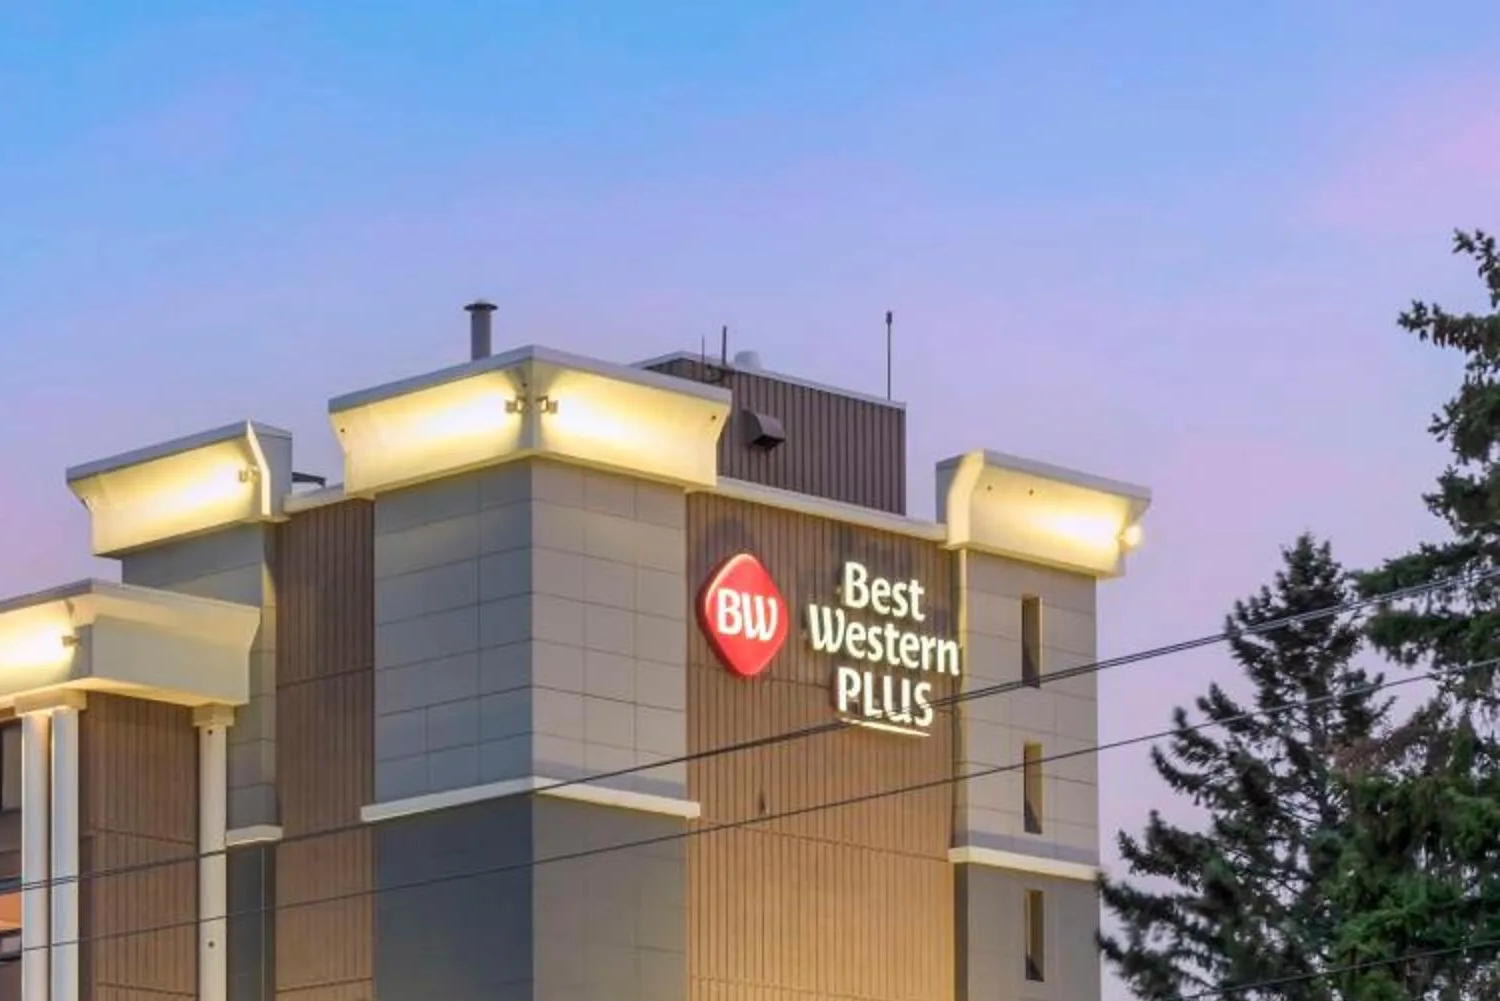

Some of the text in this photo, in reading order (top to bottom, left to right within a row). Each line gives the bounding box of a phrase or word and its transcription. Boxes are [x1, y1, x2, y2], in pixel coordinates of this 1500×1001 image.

[717, 588, 778, 641] BW
[844, 561, 925, 622] Best
[808, 603, 960, 676] Western
[837, 666, 933, 727] PLUS
